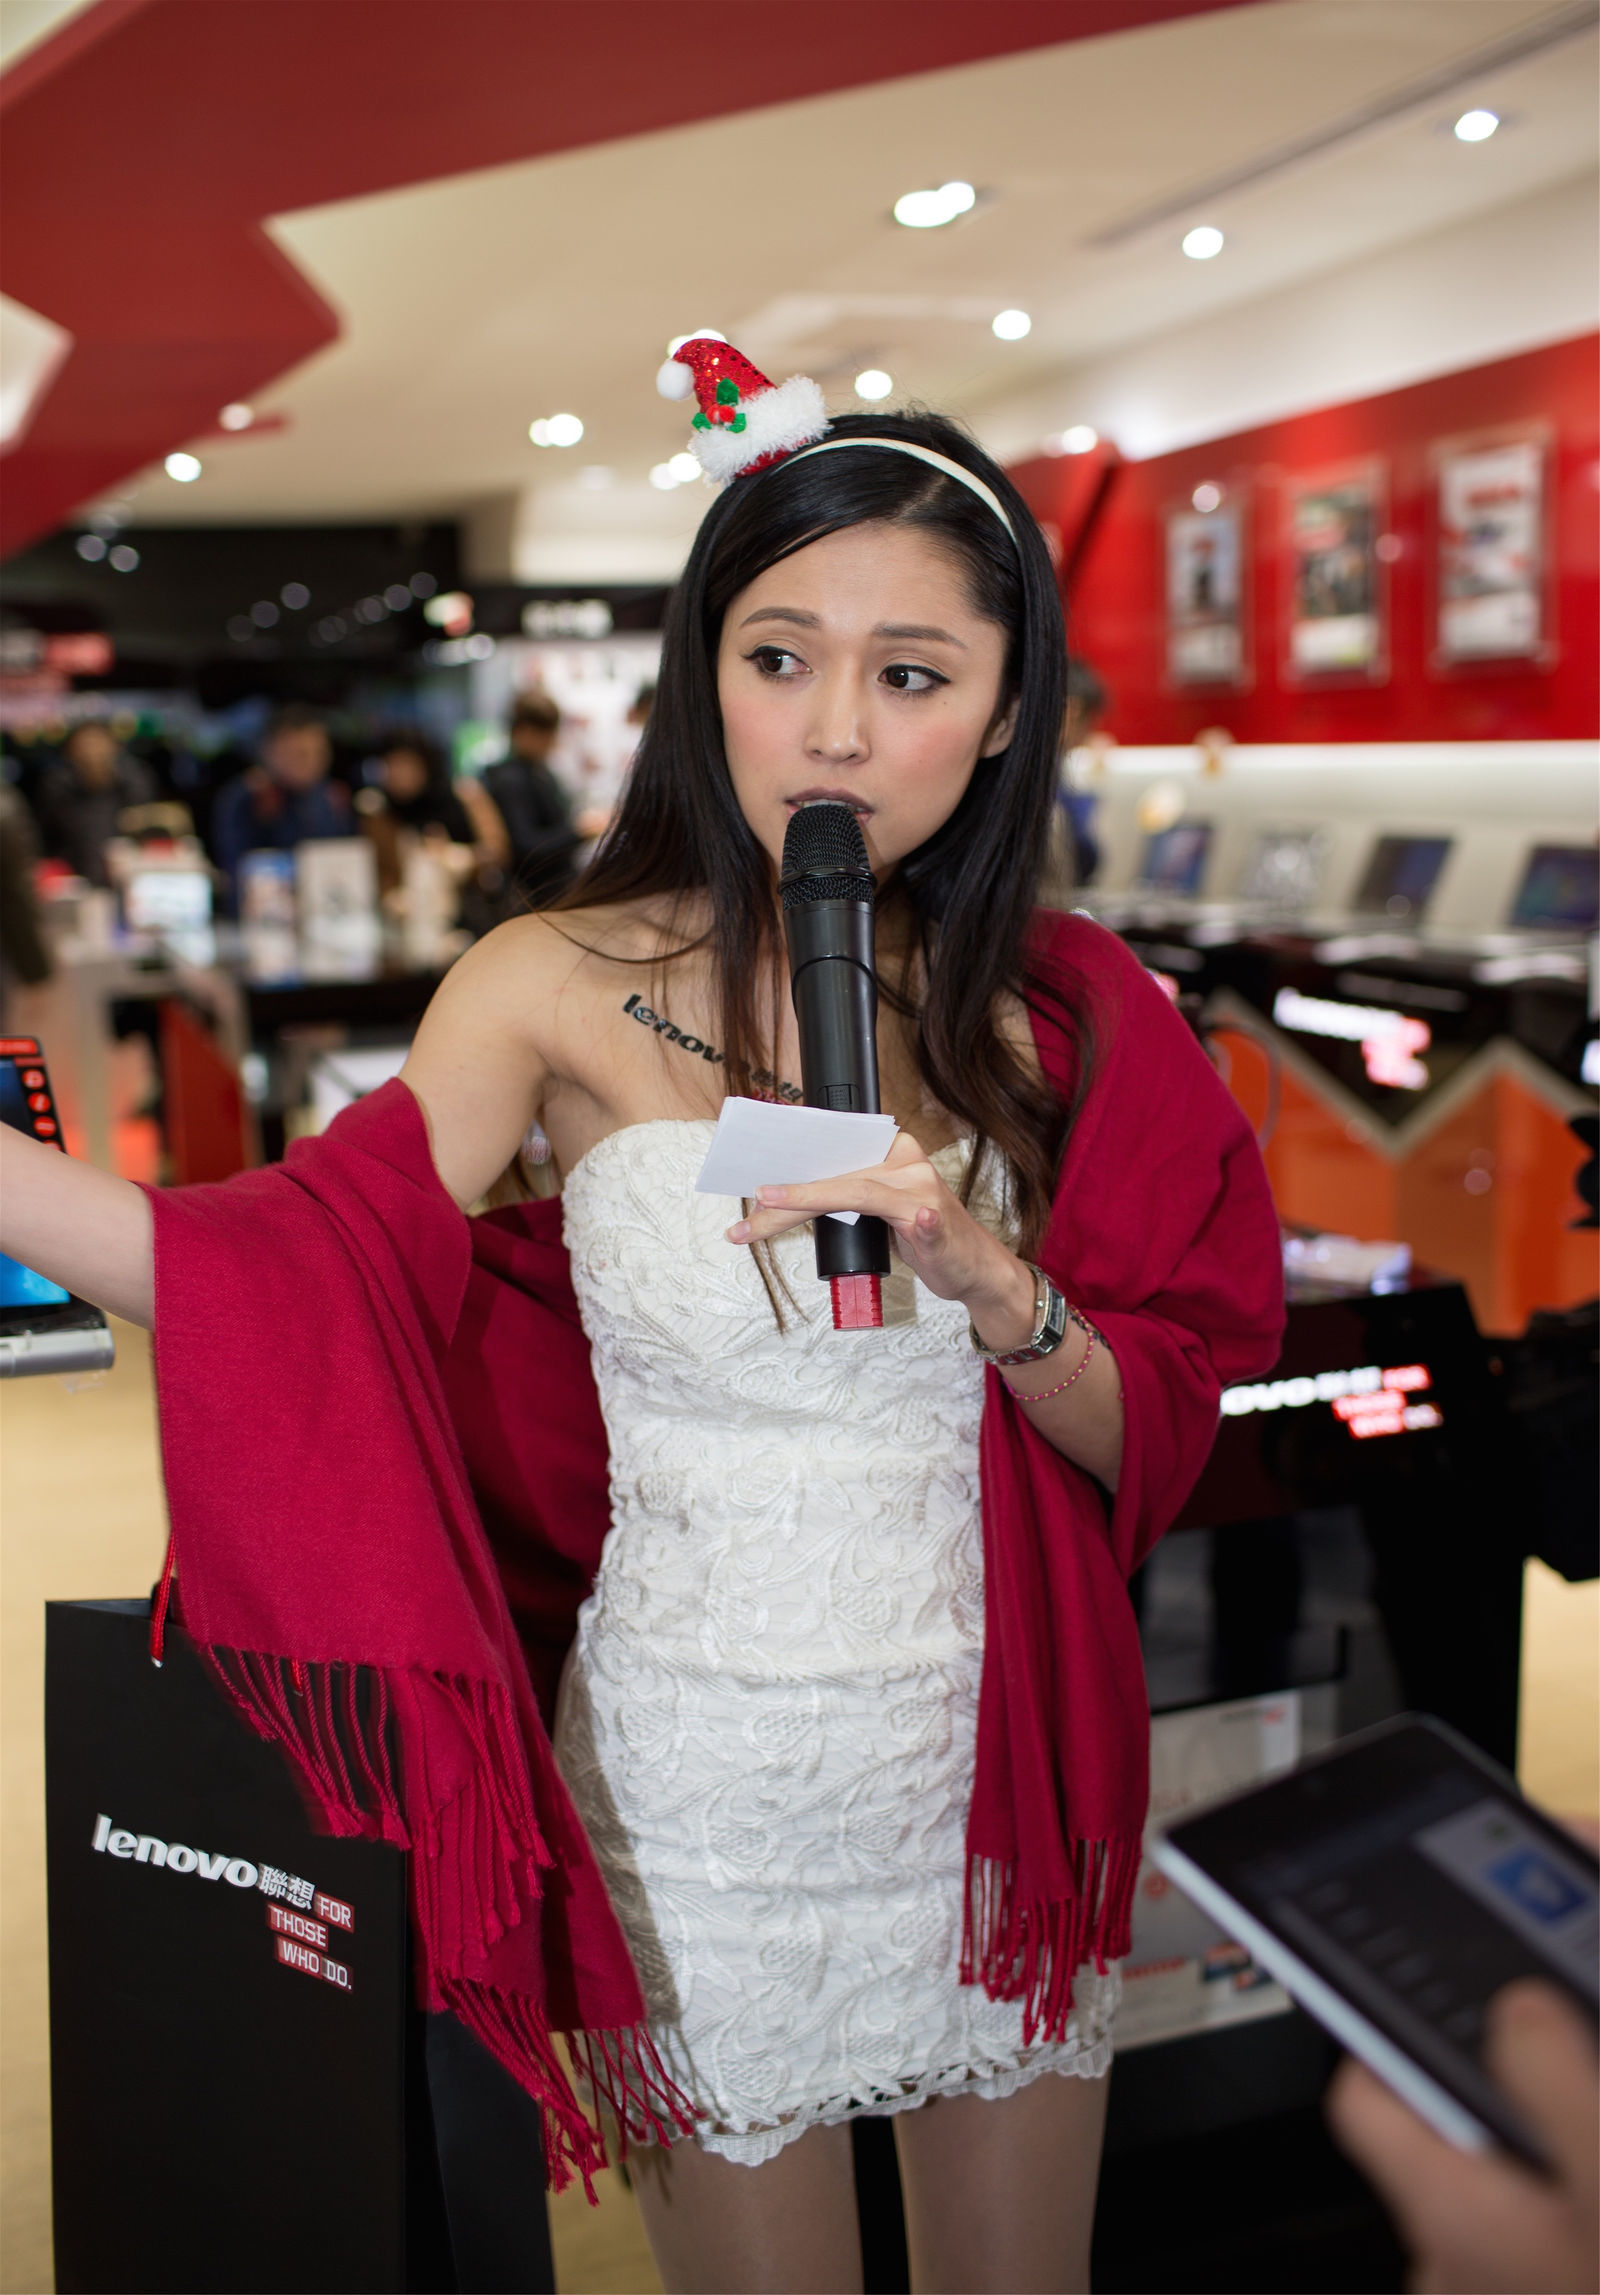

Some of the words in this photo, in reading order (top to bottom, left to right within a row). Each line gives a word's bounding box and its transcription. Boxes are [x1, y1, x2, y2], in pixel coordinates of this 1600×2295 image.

[622, 994, 748, 1070] lenov
[92, 1813, 259, 1888] lenovo
[258, 1863, 315, 1910] 聯想
[318, 1896, 352, 1929] FOR
[273, 1907, 327, 1948] THOSE
[281, 1940, 320, 1974] WHO
[325, 1959, 352, 1990] DO.
